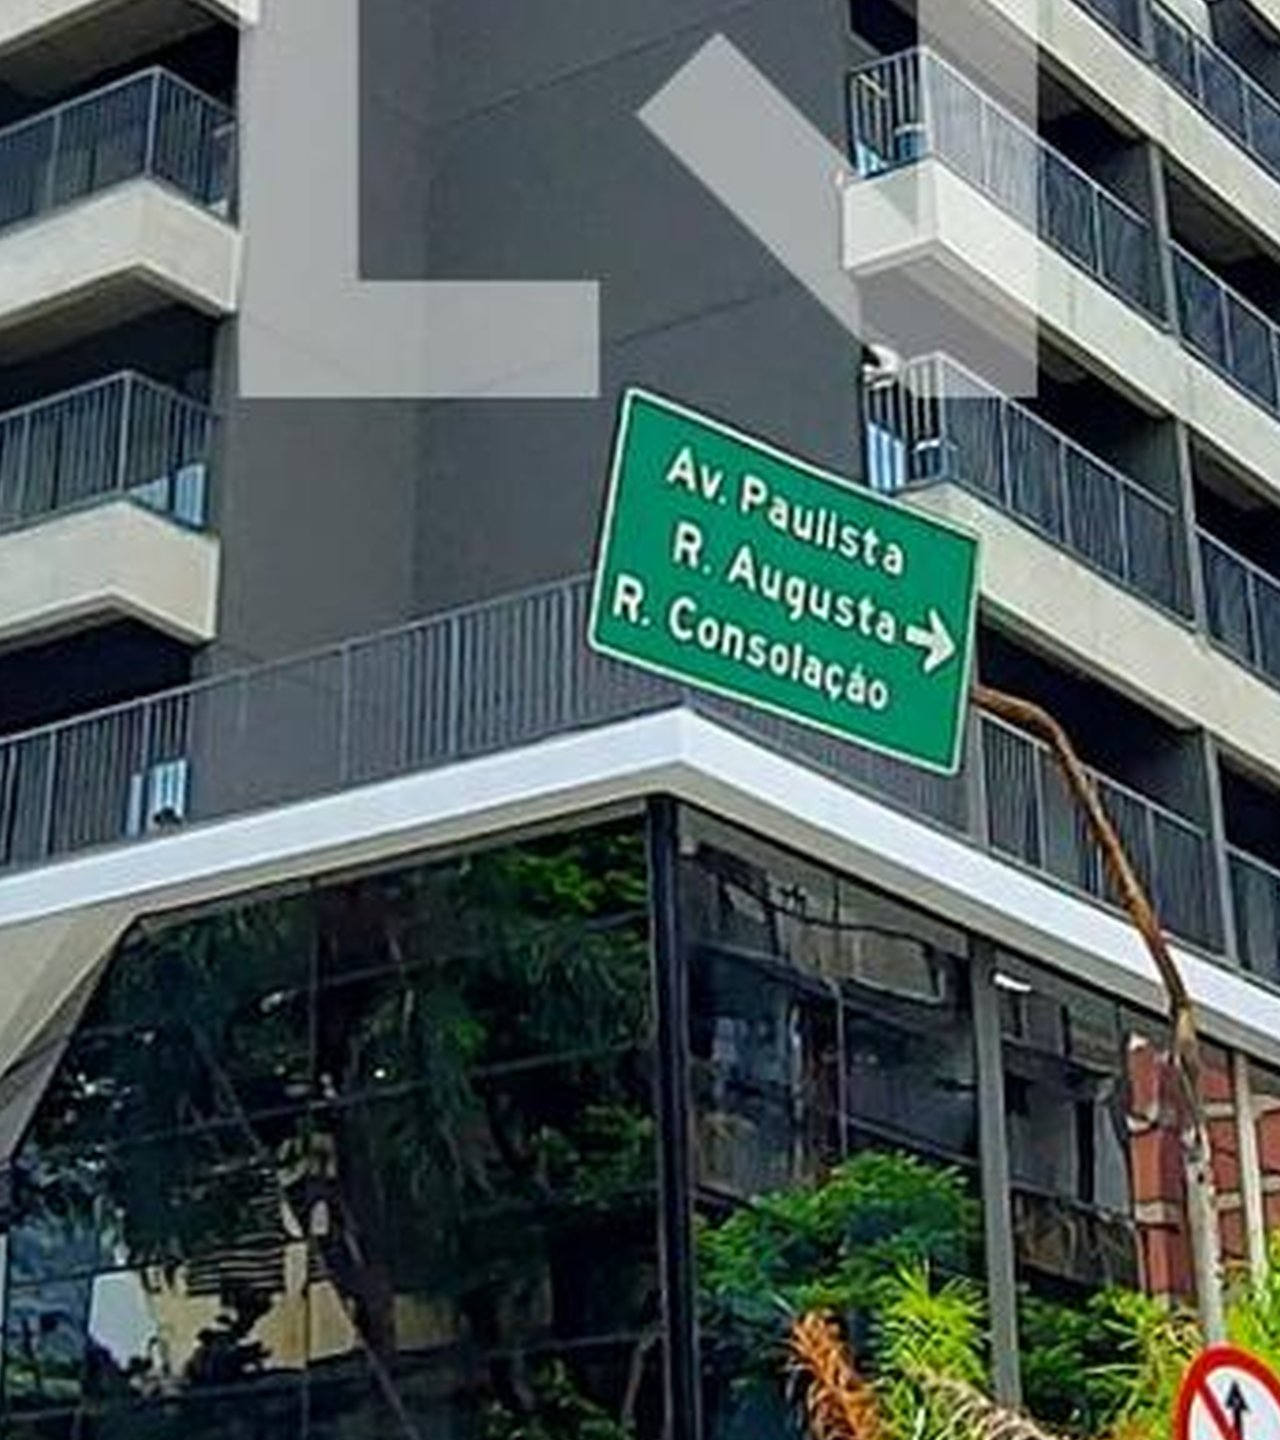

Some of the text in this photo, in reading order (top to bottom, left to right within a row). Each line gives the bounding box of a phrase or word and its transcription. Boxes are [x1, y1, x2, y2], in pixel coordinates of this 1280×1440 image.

[666, 446, 904, 576] Av. Paulista
[613, 574, 888, 709] R. Consolação
[674, 522, 896, 643] R. Augusta
